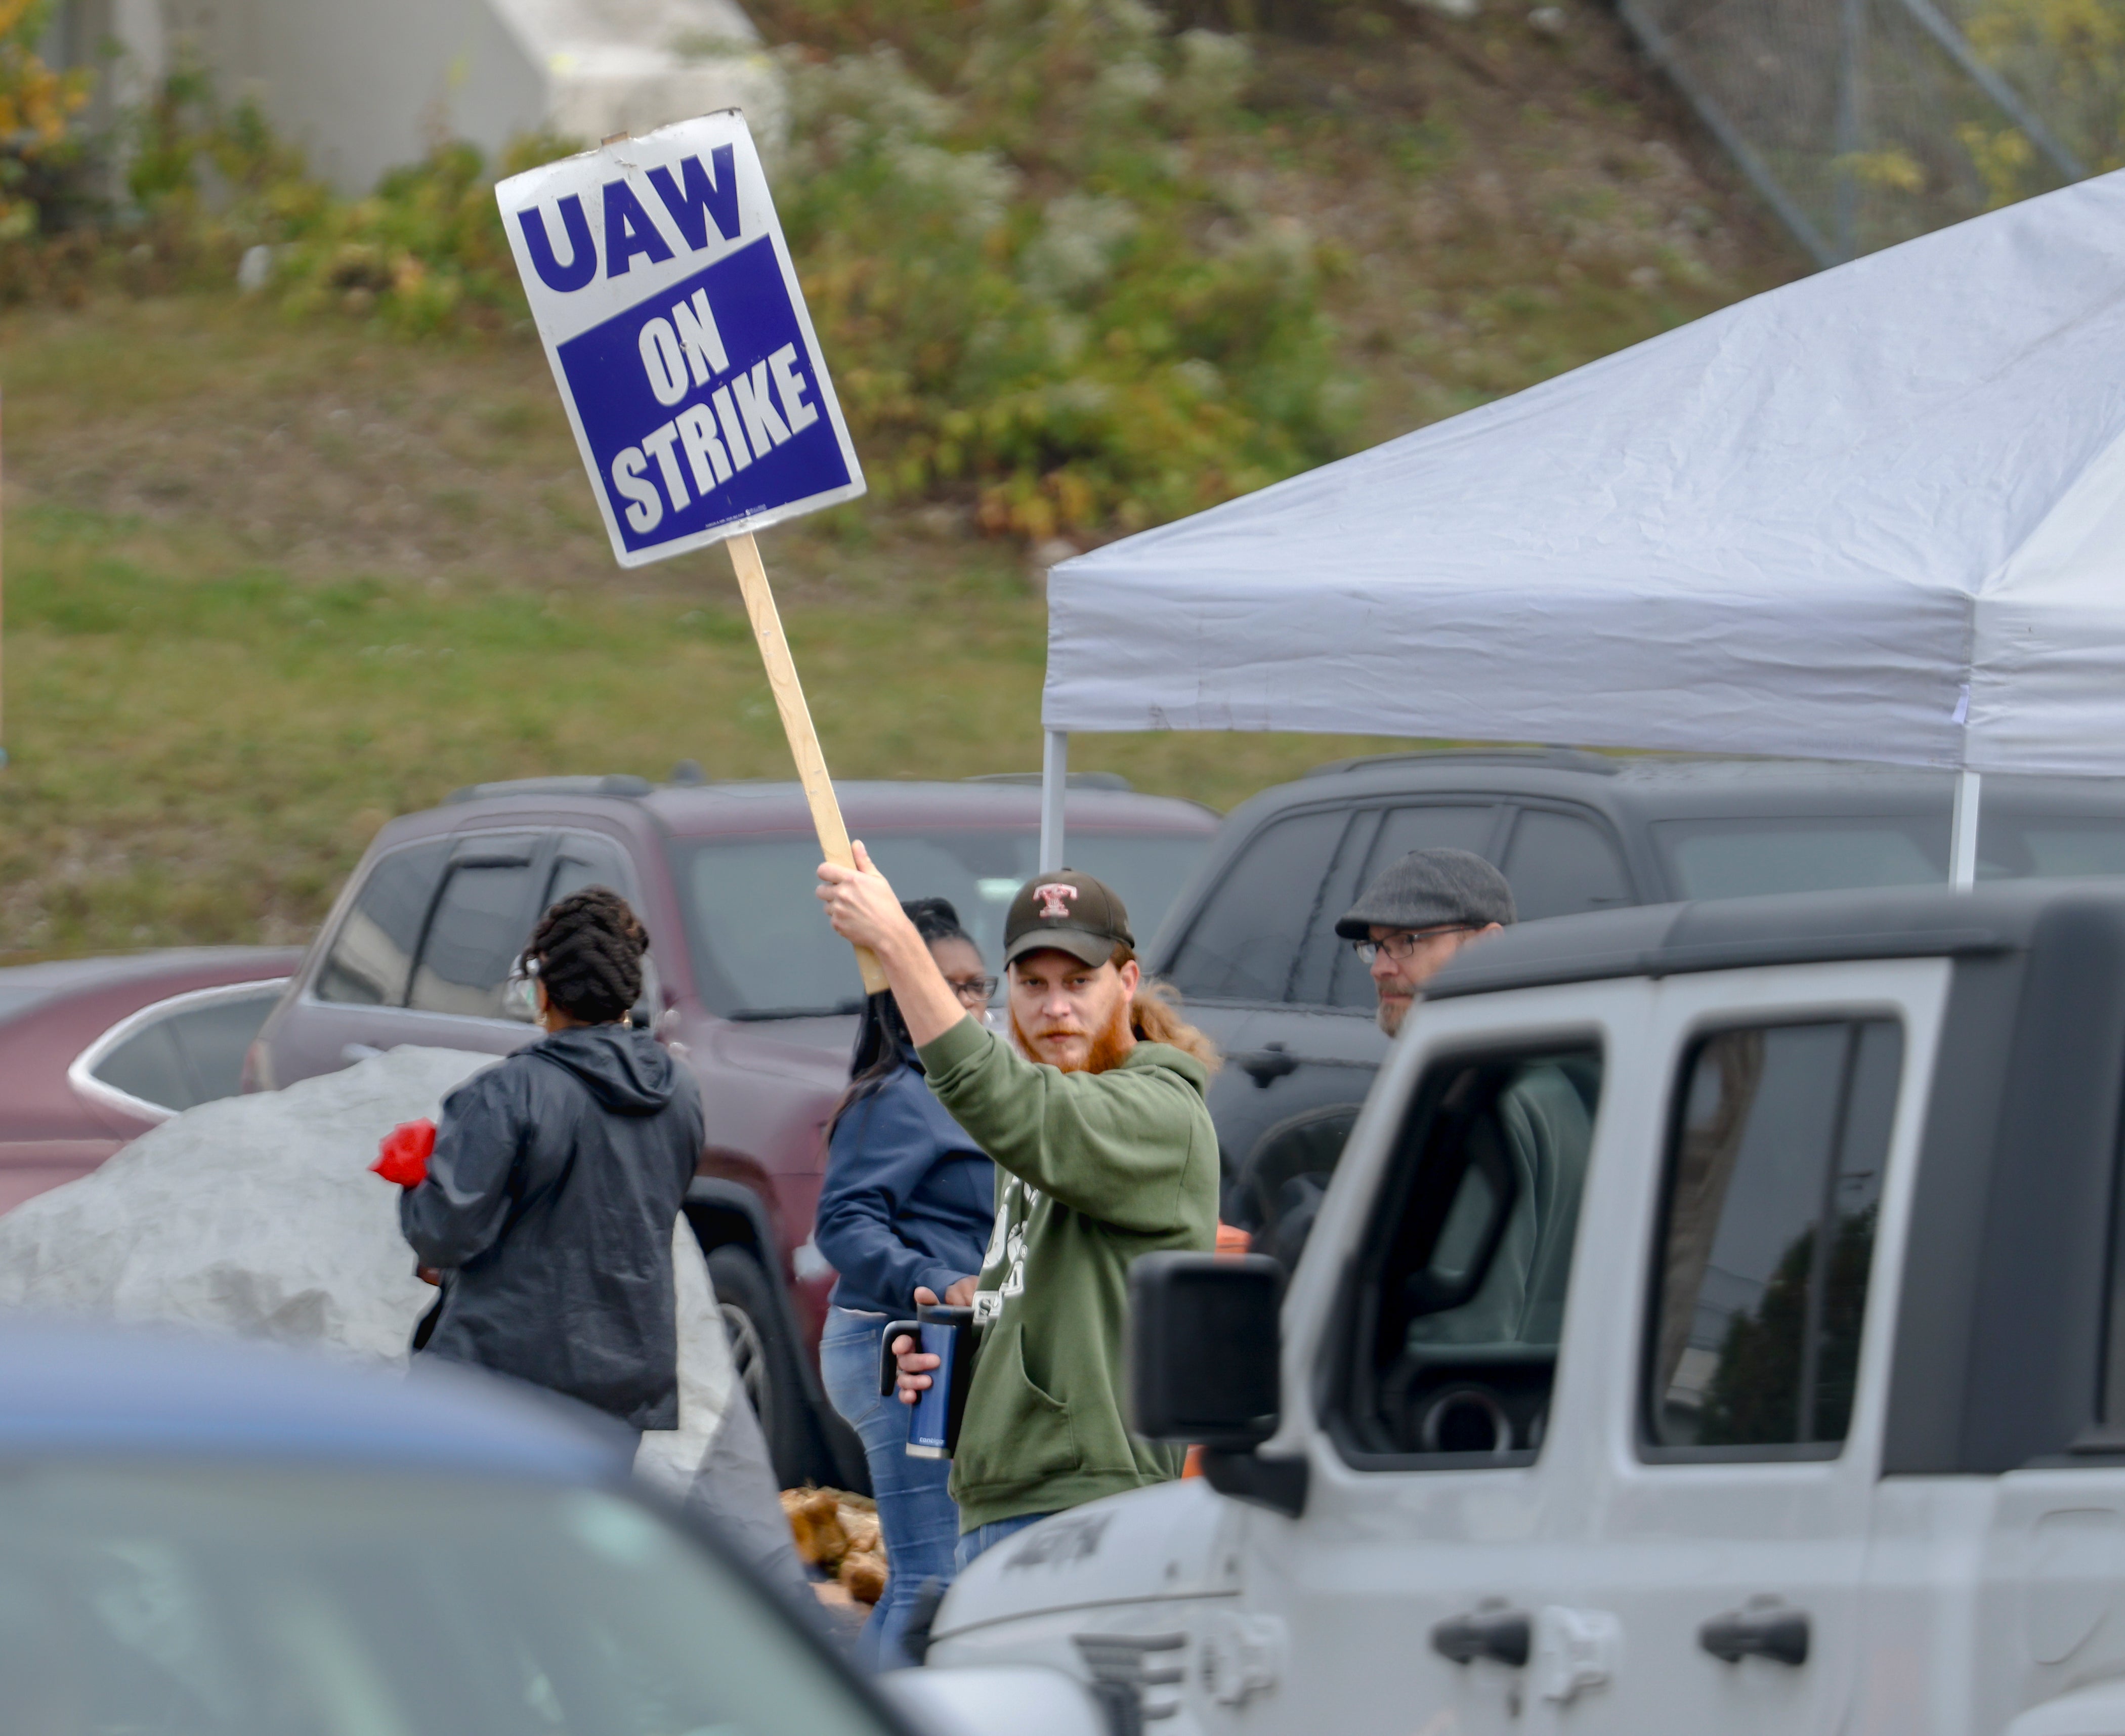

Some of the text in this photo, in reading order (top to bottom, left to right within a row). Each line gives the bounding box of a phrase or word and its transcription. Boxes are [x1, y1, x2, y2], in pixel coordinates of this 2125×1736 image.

[518, 143, 741, 292] UAW
[638, 287, 730, 406] ON
[611, 342, 819, 534] STRIKE
